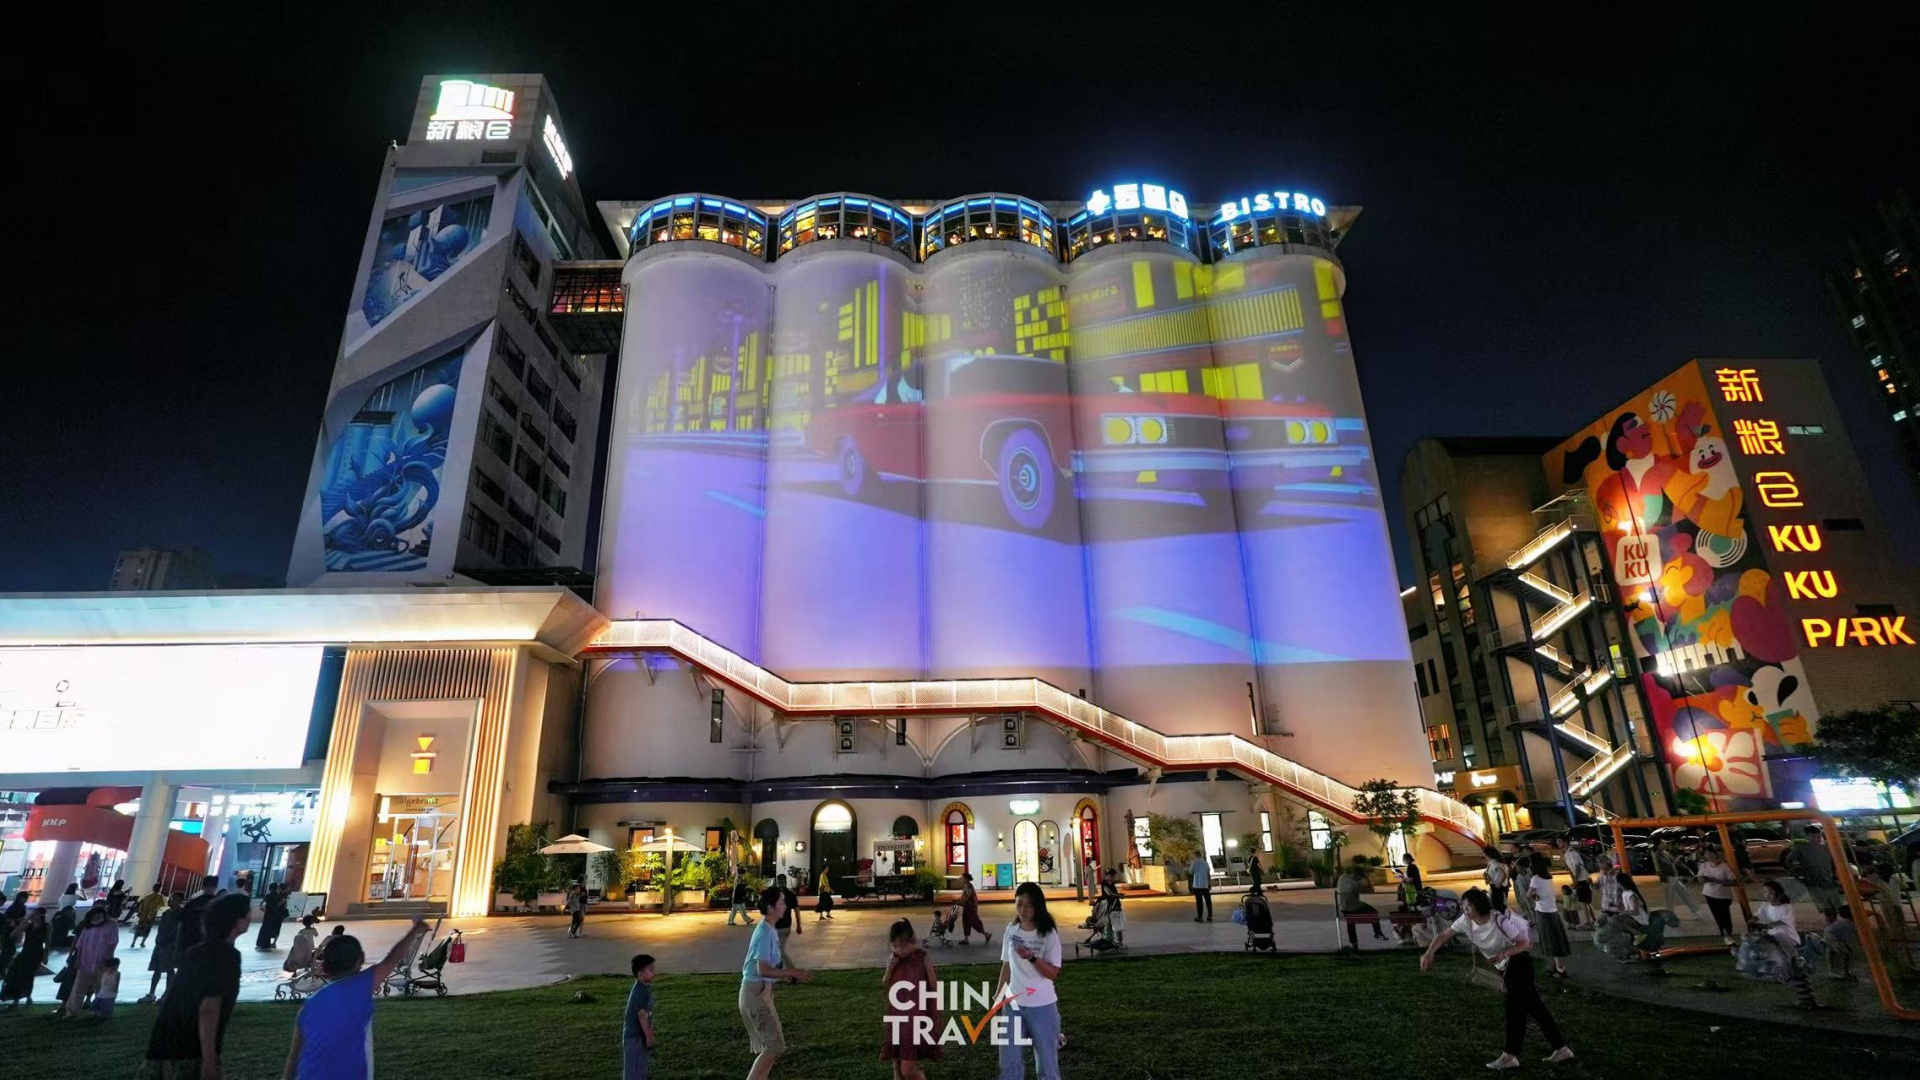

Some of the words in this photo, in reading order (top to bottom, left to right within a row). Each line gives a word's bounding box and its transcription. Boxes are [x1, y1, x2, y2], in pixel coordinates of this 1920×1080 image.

[426, 120, 512, 141] 新粮仓
[1220, 191, 1326, 222] BISTRO
[1715, 368, 1804, 507] 新粮仓
[1623, 543, 1650, 561] KU
[1767, 524, 1822, 552] KU
[1624, 561, 1650, 579] KU
[1784, 570, 1838, 599] KU
[1801, 616, 1917, 648] PARK
